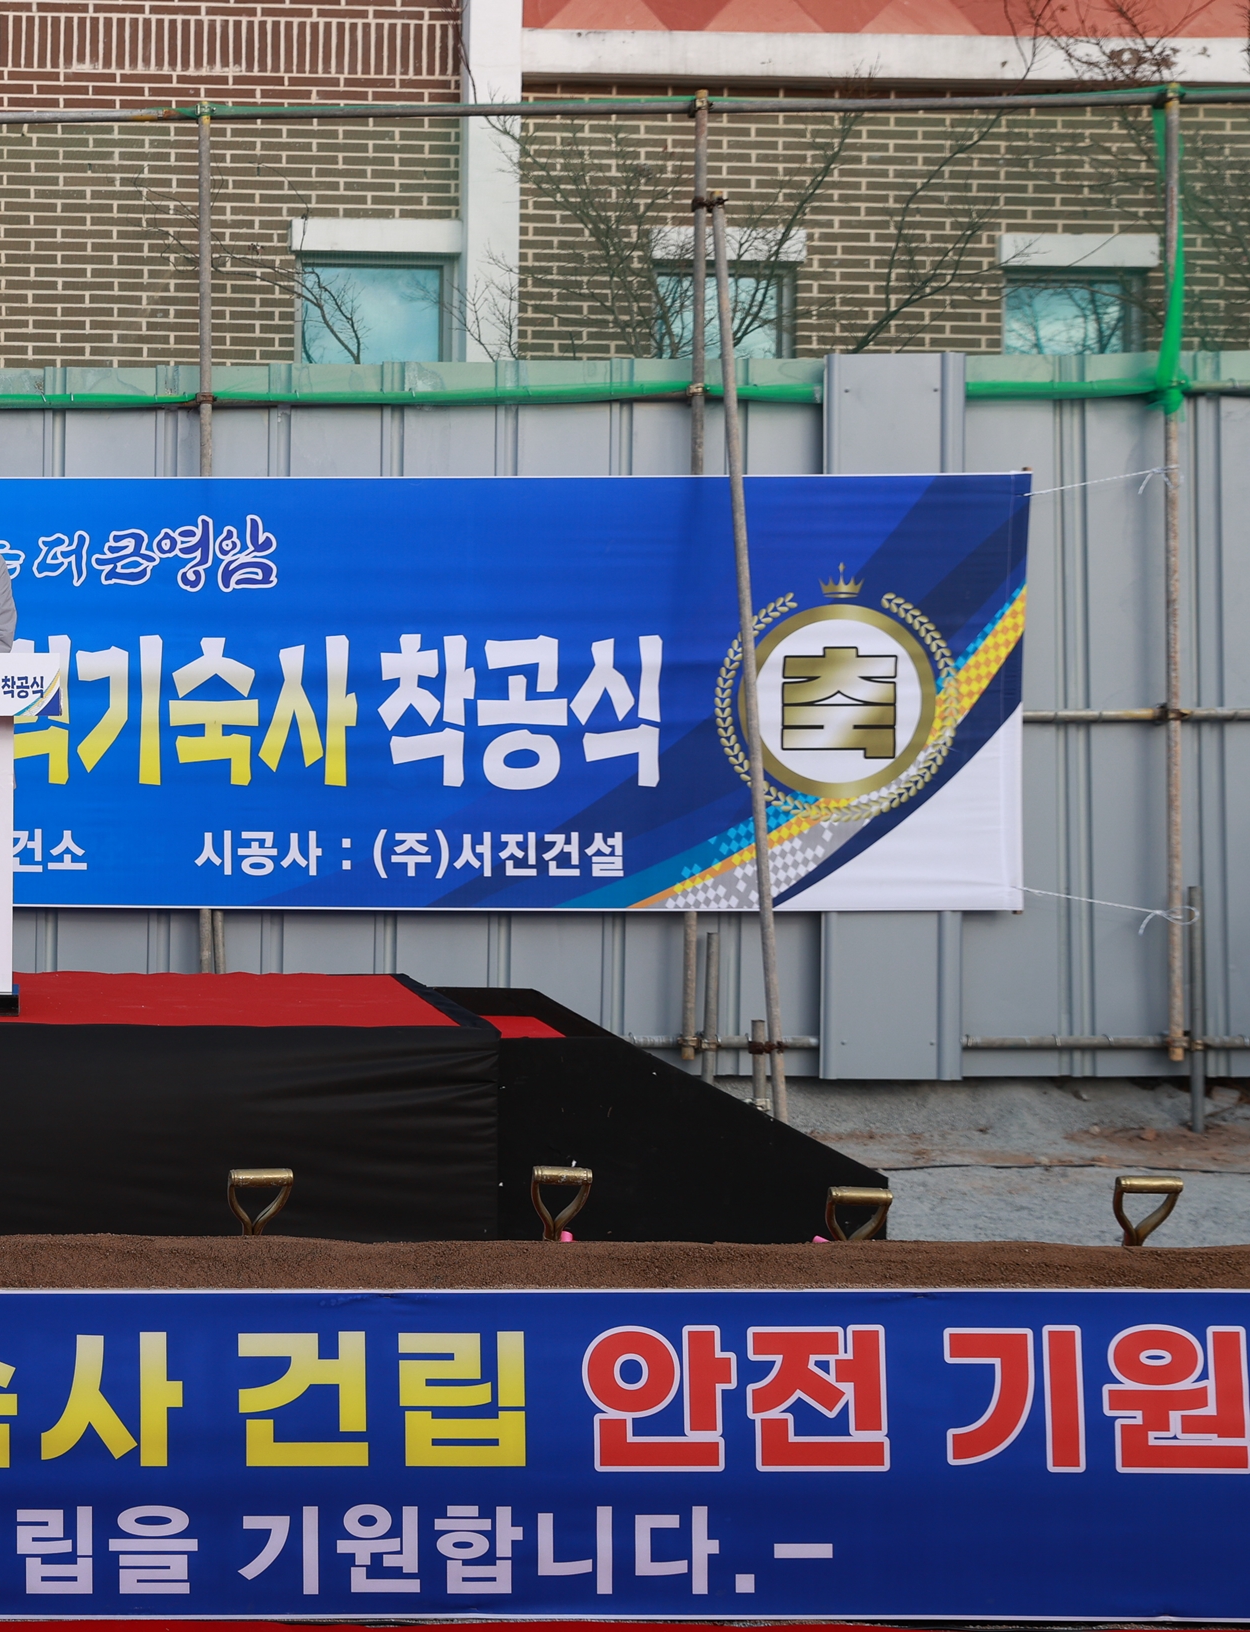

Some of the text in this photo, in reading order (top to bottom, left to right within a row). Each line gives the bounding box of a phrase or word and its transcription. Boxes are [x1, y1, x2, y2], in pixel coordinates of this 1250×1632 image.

[32, 530, 90, 587] 더
[1, 675, 44, 698] 착공식
[377, 633, 662, 790] 착공식
[782, 646, 897, 759] 축
[195, 831, 321, 876] 시공사
[373, 829, 625, 878] (주)서진건설
[238, 1331, 527, 1468] 건립
[582, 1324, 891, 1473] 안전
[944, 1323, 1250, 1475] 기원
